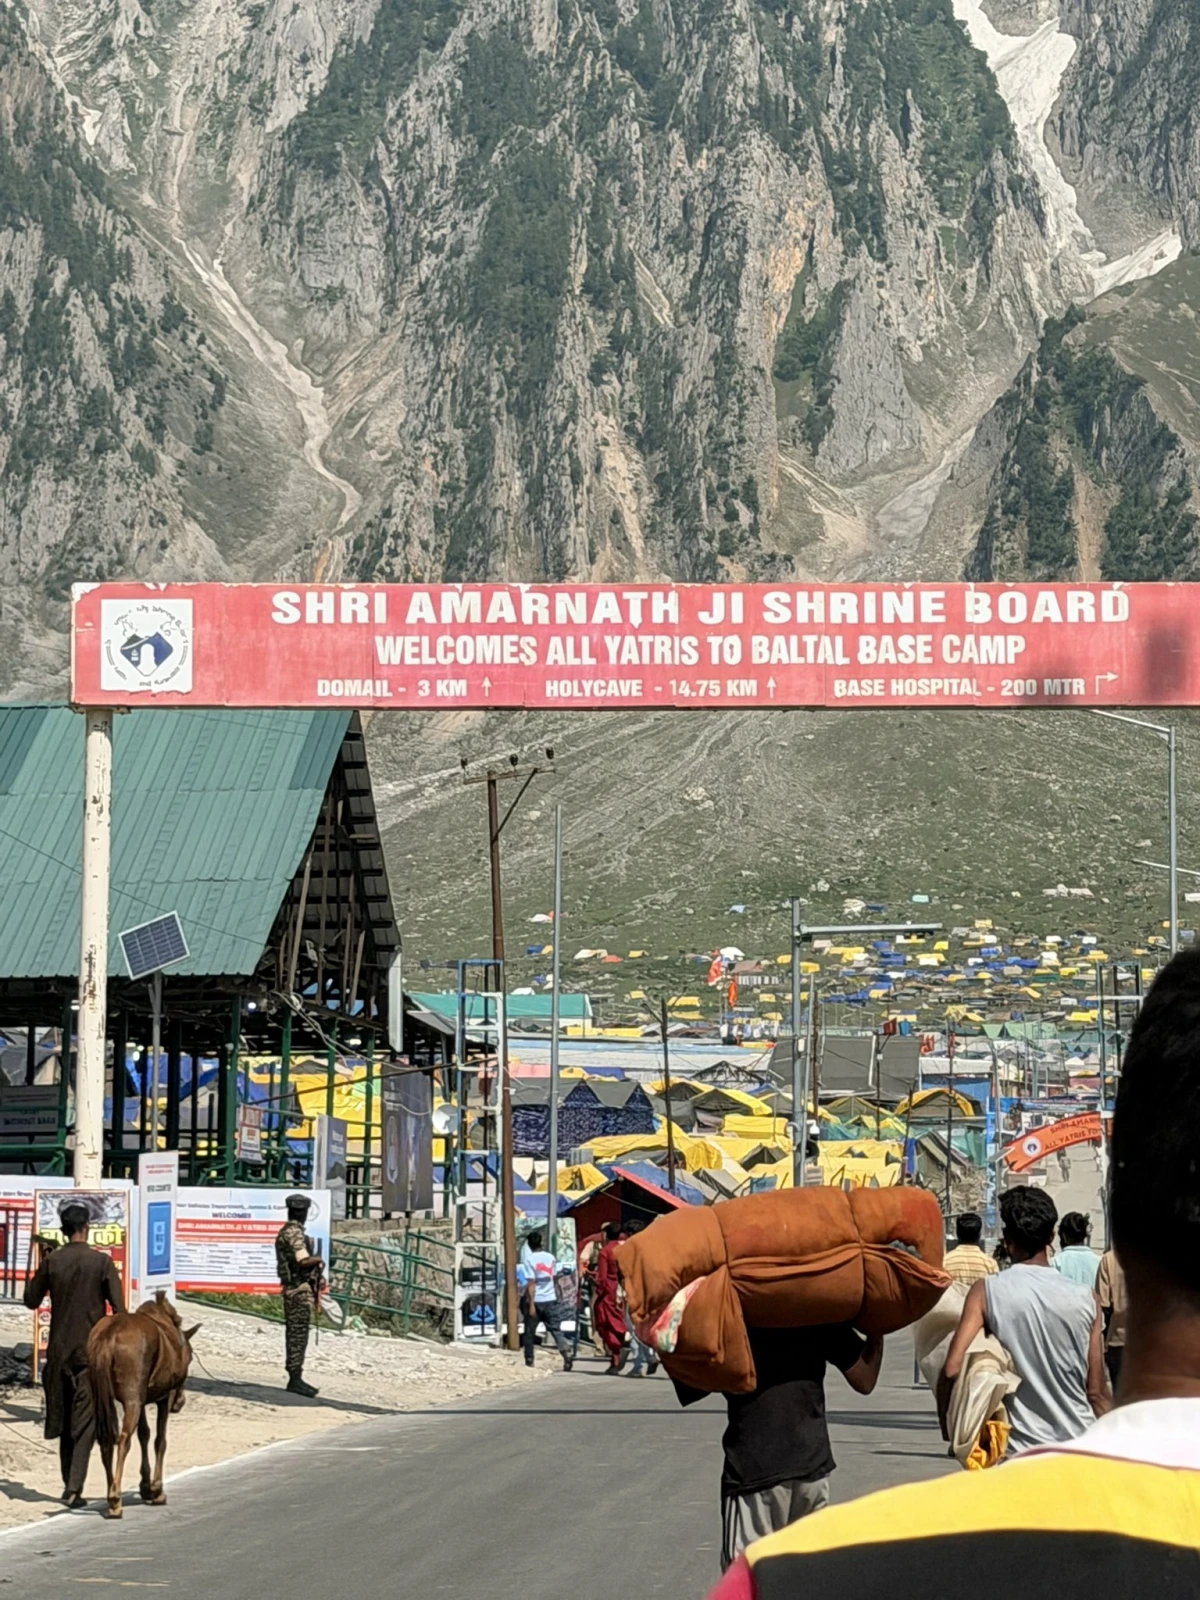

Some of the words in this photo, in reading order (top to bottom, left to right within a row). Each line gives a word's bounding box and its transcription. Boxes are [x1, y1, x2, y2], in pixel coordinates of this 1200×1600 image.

[271, 591, 387, 625] SHRI
[405, 591, 680, 627] AMARNATH
[697, 591, 744, 625] JI
[762, 591, 946, 625] SHRINE
[964, 591, 1131, 625] BOARD
[374, 634, 538, 666] WELCOMES
[545, 635, 597, 666] ALL
[603, 634, 700, 666] YATRIS
[706, 634, 743, 666] TO
[751, 634, 851, 666] BALTAL
[857, 634, 933, 666] BASE
[940, 633, 1026, 665] CAMP
[316, 678, 393, 698] DOMAIL
[418, 679, 431, 698] 3
[436, 678, 468, 698] KM
[545, 678, 643, 698] HOLYCAVE
[670, 679, 721, 697] 14.75
[727, 679, 758, 697] KM
[833, 678, 885, 698] BASE
[890, 677, 981, 697] HOSPITAL
[1001, 678, 1037, 697] 200
[1042, 678, 1085, 697] MTR
[1045, 1141, 1059, 1151] ALL
[1060, 1130, 1086, 1143] YATRIS
